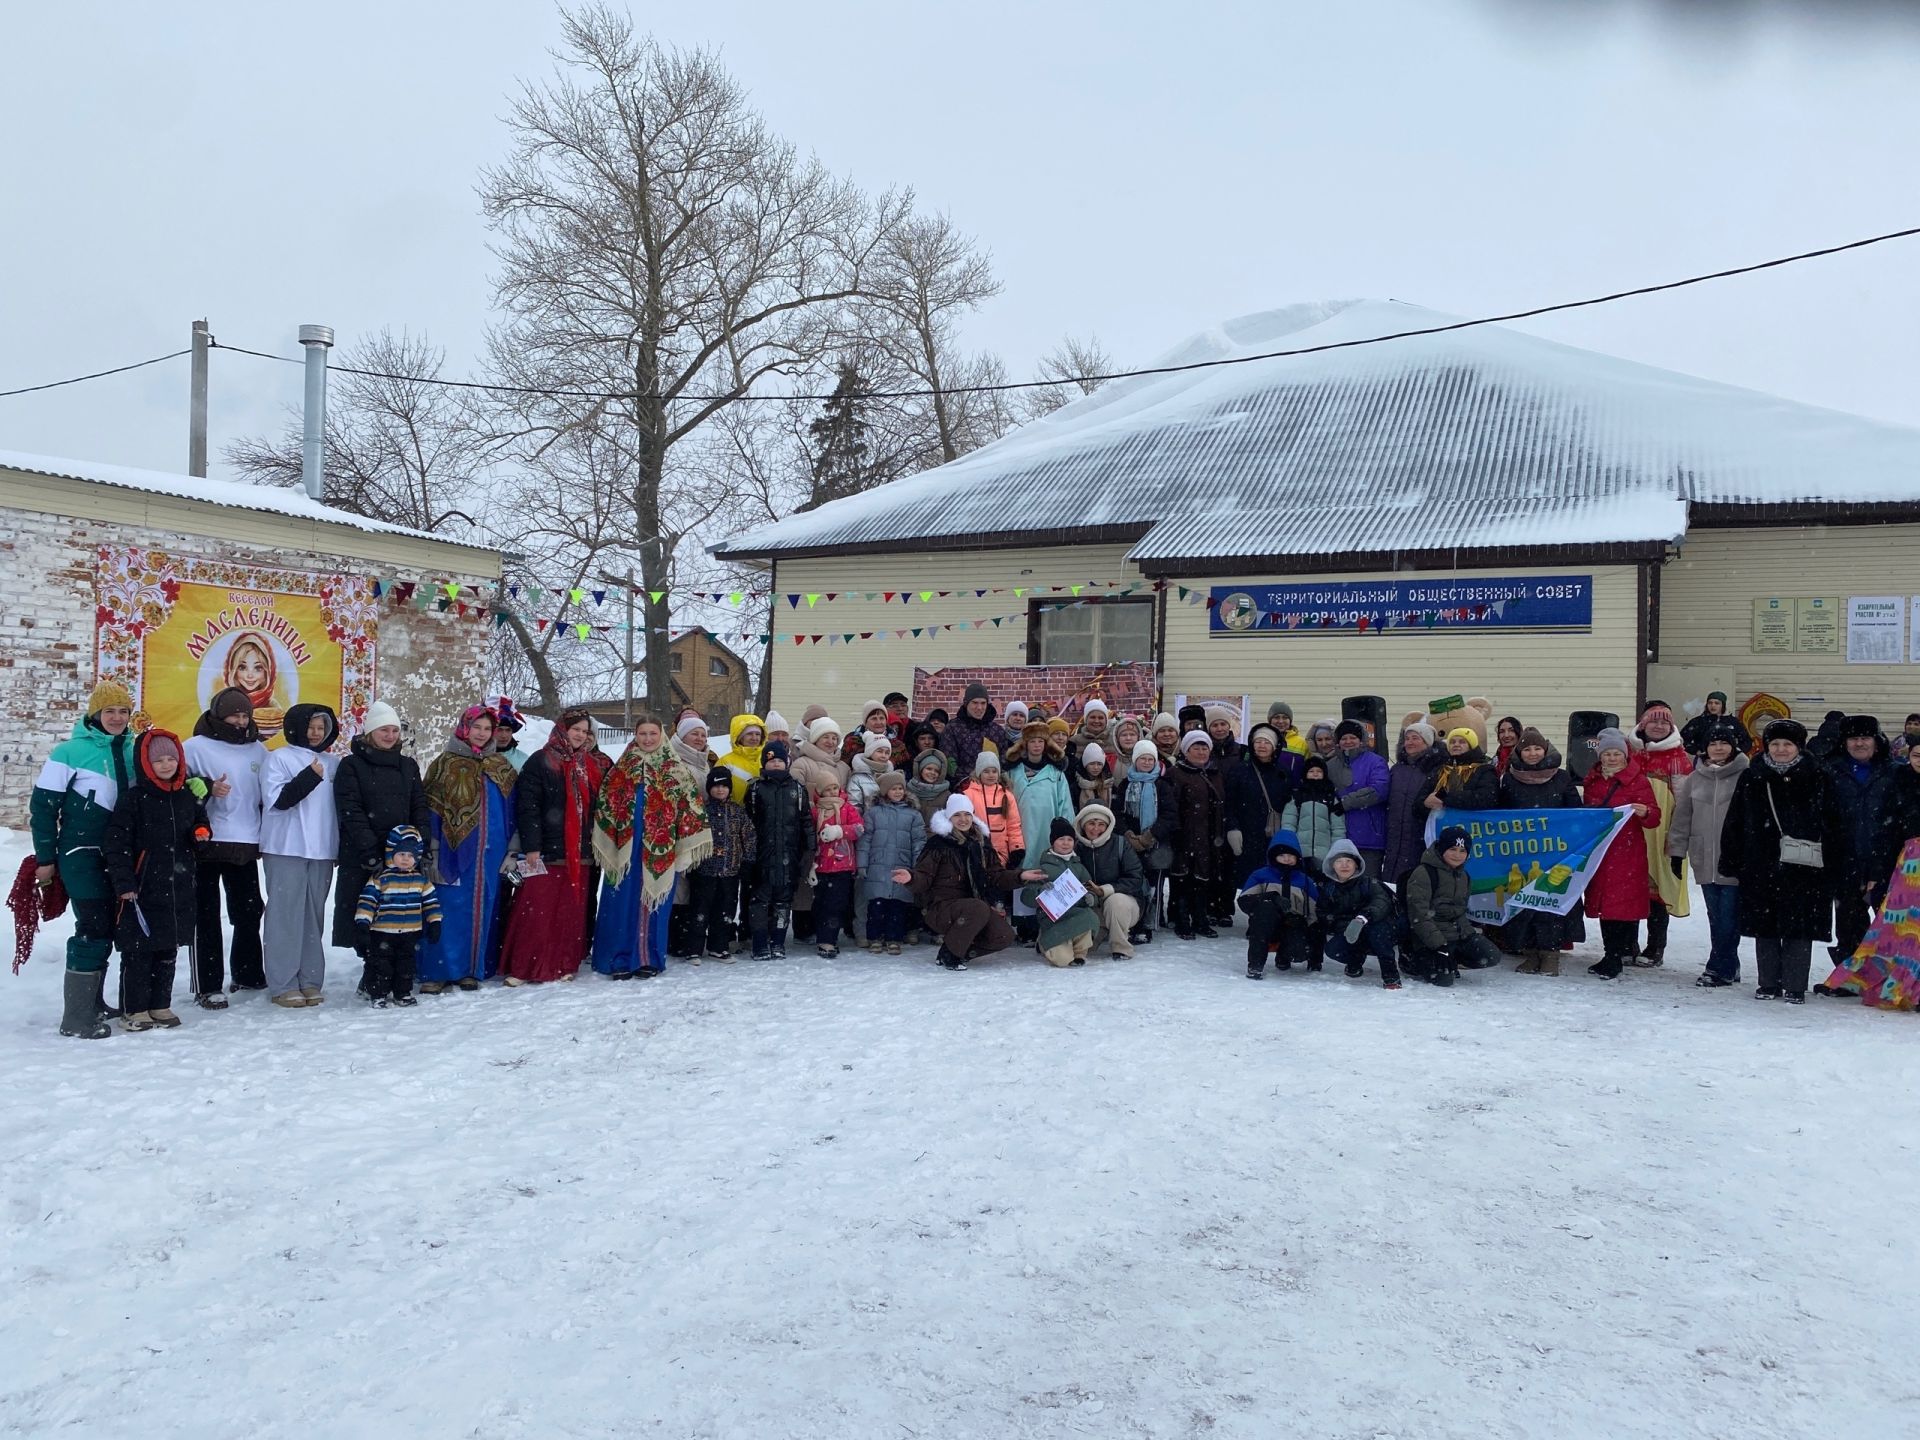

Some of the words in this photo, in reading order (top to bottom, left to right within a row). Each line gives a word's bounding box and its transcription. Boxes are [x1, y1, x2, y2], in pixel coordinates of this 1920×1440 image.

[228, 592, 274, 606] ВЕСЕЛОЙ
[1267, 586, 1398, 606] ТЕРРИТОРИАЛЬНЫЙ
[1408, 583, 1527, 604] ОБЩЕСТВЕННЫЙ
[1536, 584, 1582, 599] СОВЕТ
[186, 607, 312, 665] МАСЛЕНИЦЫ
[1442, 816, 1549, 839] ДСОВЕТ
[1468, 836, 1568, 859] СТОПОЛЬ
